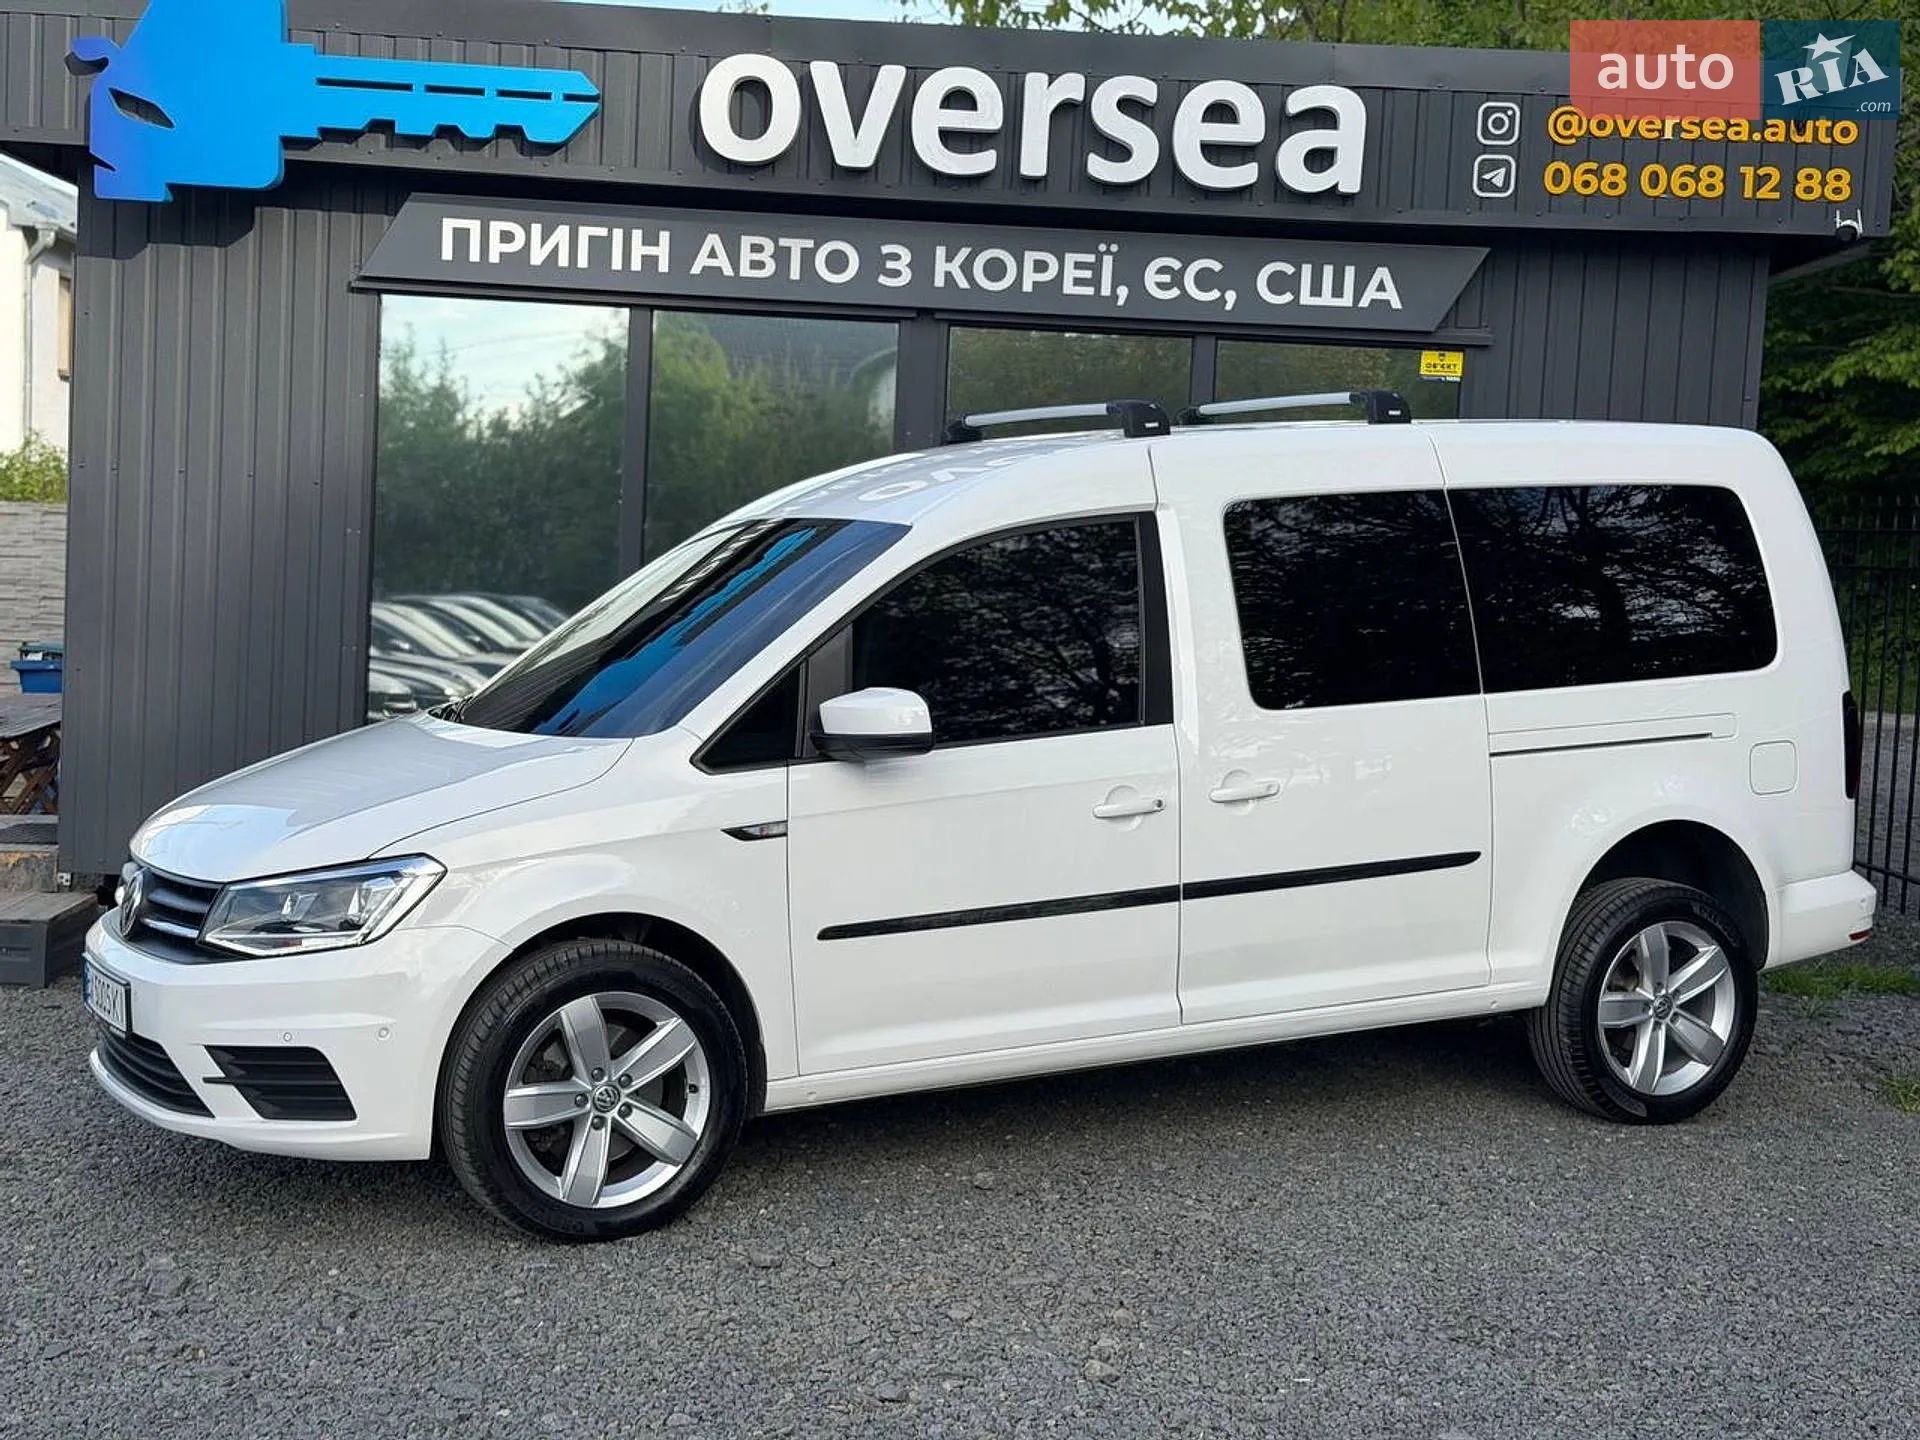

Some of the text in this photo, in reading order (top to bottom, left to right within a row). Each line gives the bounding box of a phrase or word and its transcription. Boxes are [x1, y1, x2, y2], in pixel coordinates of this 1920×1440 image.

[698, 53, 1367, 195] oversea
[1548, 105, 1859, 145] @oversea.auto
[1544, 161, 1851, 202] 068 068 12 88
[441, 217, 671, 273] ПРИГІН
[690, 233, 860, 284] АВТО
[933, 243, 1129, 306] КОРЕЇ,
[1143, 257, 1237, 310] ЄС,
[1256, 261, 1403, 309] США
